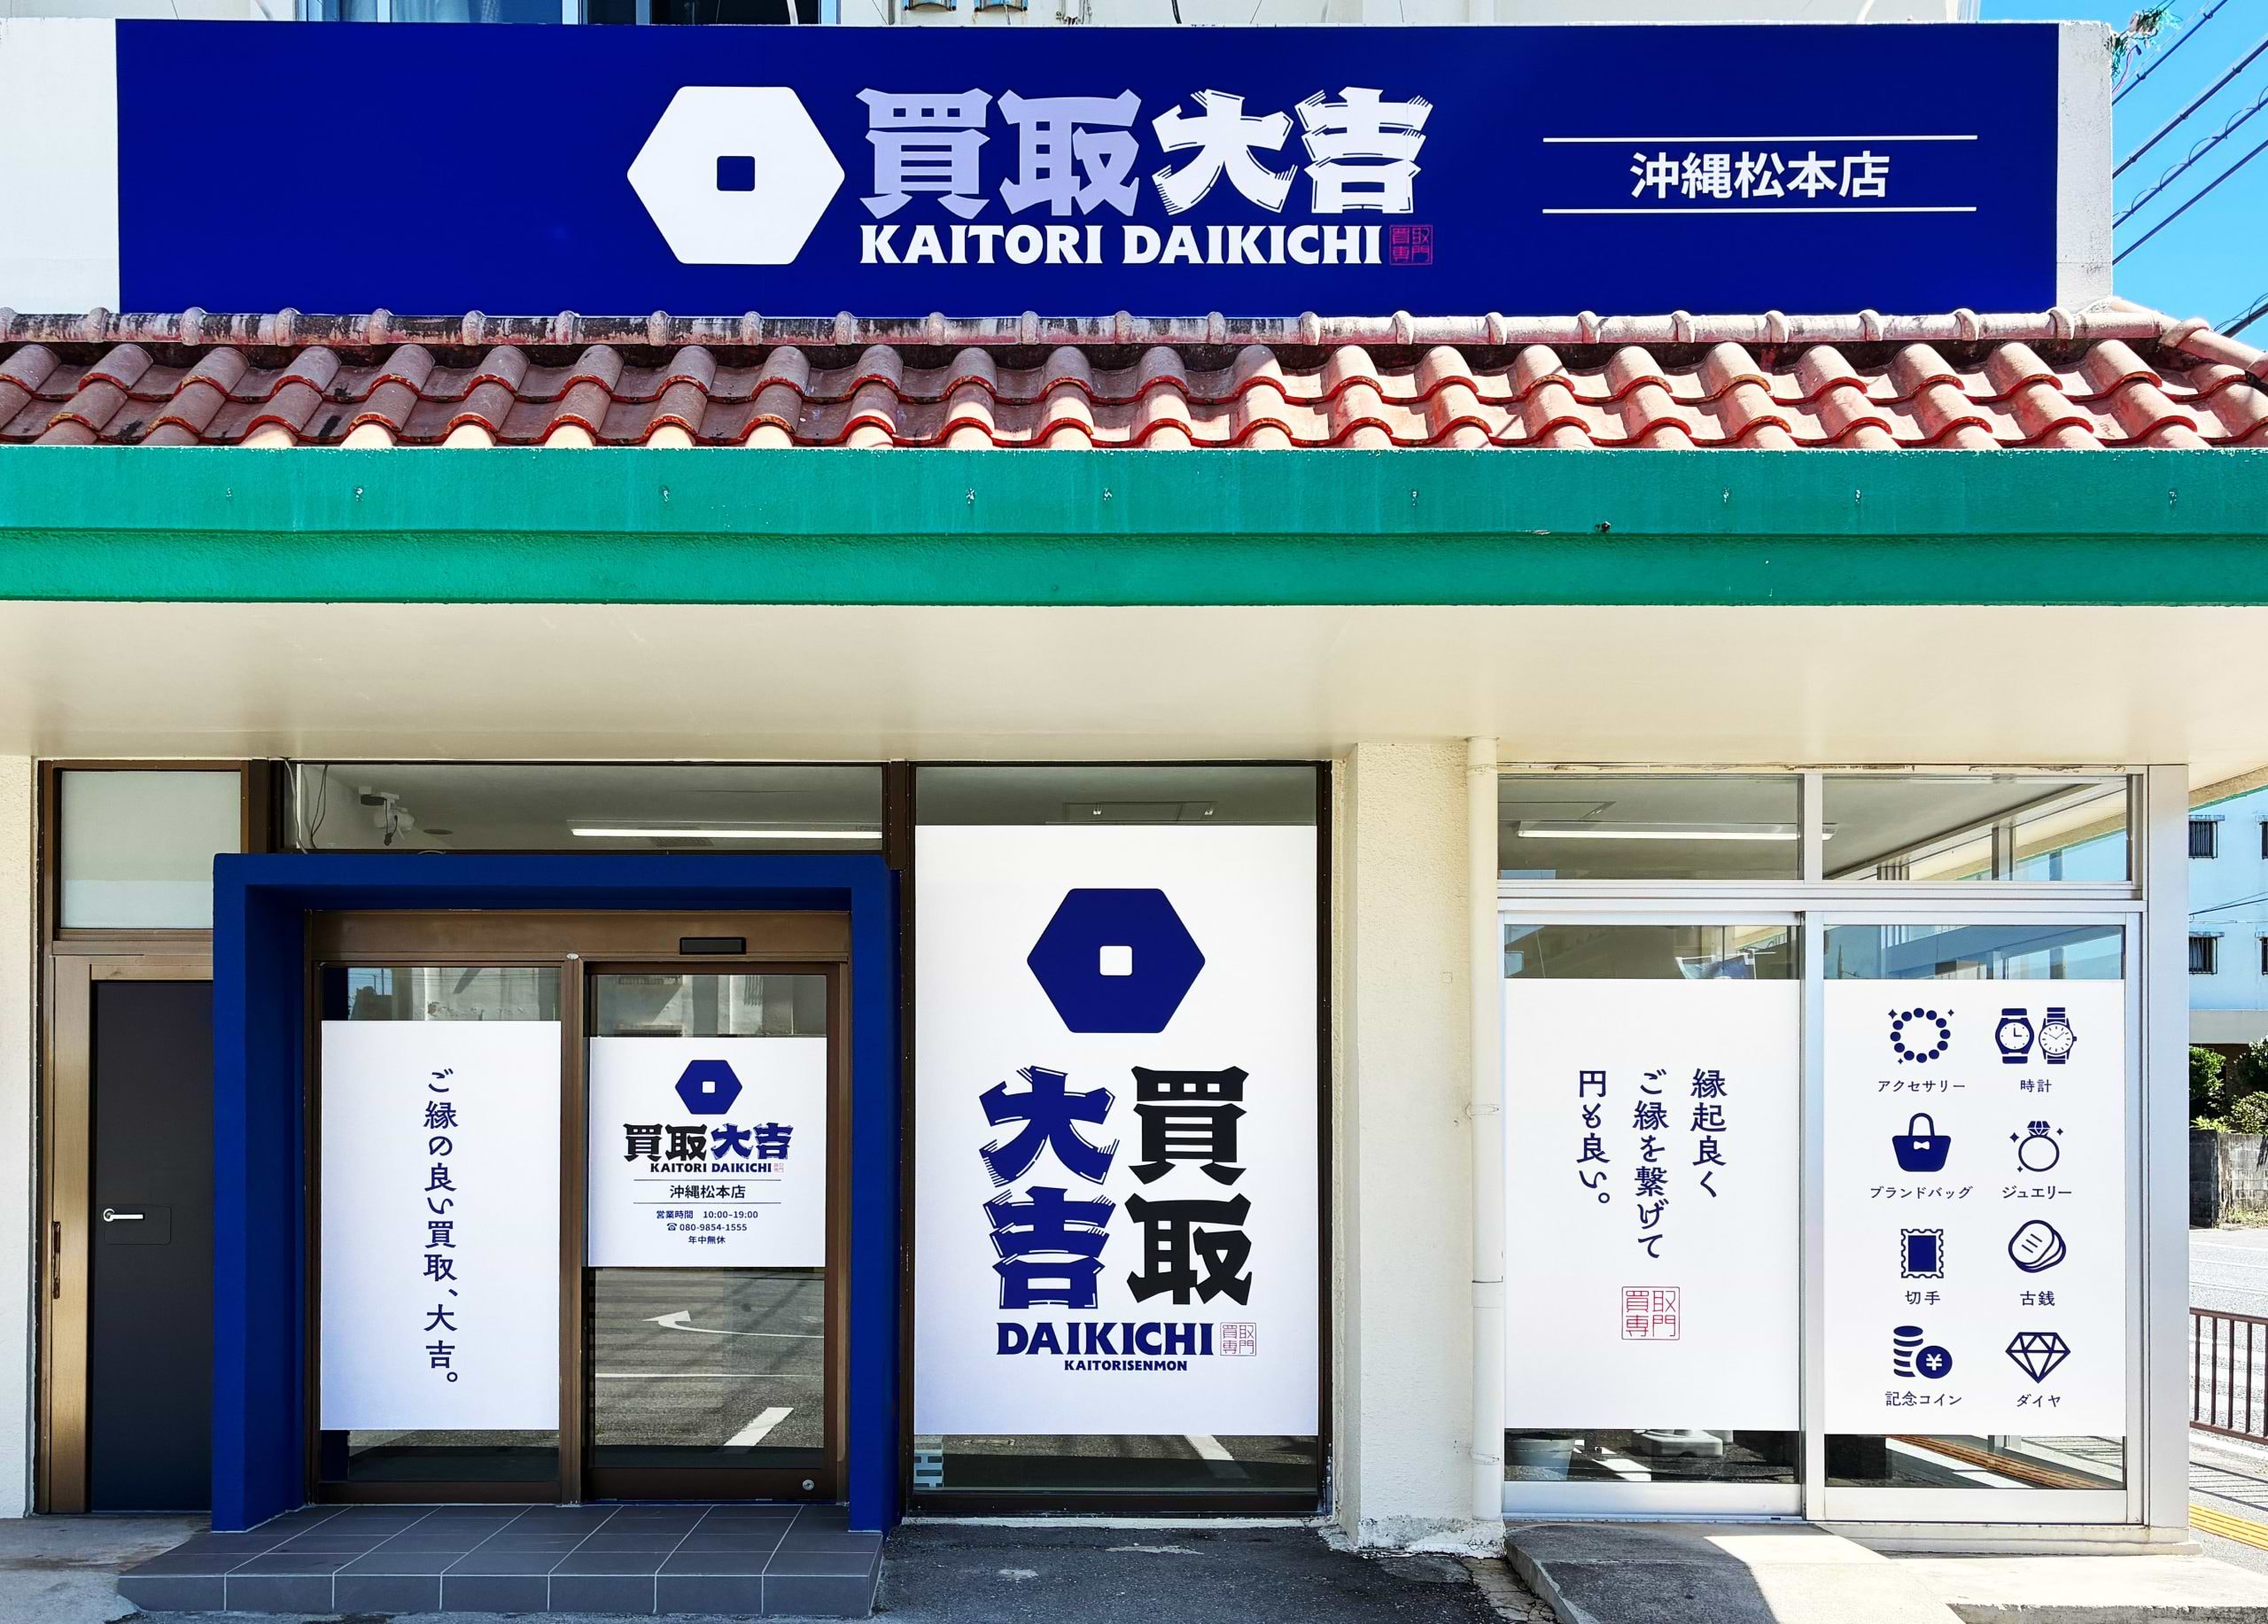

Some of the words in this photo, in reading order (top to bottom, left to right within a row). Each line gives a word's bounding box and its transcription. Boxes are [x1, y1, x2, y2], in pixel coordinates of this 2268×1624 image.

[855, 86, 1434, 219] 買取大吉
[1630, 151, 1891, 199] 沖縄松本店
[860, 224, 1104, 265] KAITORI
[1122, 224, 1383, 265] DAIKICHI
[1878, 1080, 1966, 1093] アクセサリー
[2020, 1079, 2053, 1093] 時計
[1576, 1070, 1611, 1205] 円も良い。
[1690, 1068, 1728, 1199] 縁起良く
[623, 1123, 794, 1162] 買取大吉
[650, 1163, 707, 1173] KAITORI
[711, 1163, 772, 1173] DAIKICHI
[1632, 1068, 1670, 1259] ご縁を繋げて
[670, 1185, 746, 1200] 沖縄松本店
[979, 1066, 1121, 1309] 大吉
[1125, 1066, 1253, 1306] 買取
[1870, 1185, 1974, 1200] ブランドバッグ
[2002, 1185, 2072, 1200] ジュエリー
[656, 1209, 694, 1219] 営業時間
[423, 1068, 459, 1383] ご縁の良い買取、大吉。
[688, 1235, 726, 1245] 年中無休
[1626, 1290, 1676, 1312] 買取
[1905, 1291, 1941, 1306] 切手
[2020, 1291, 2055, 1307] 古銭
[1223, 1325, 1254, 1339] 買取
[1626, 1315, 1676, 1337] 専門
[996, 1321, 1215, 1356] DAIKICHI
[1223, 1340, 1254, 1354] 専門
[1065, 1360, 1188, 1371] KAITORISENMON
[1885, 1391, 1962, 1407] 記念コイン
[2016, 1394, 2061, 1408] ダイヤ
